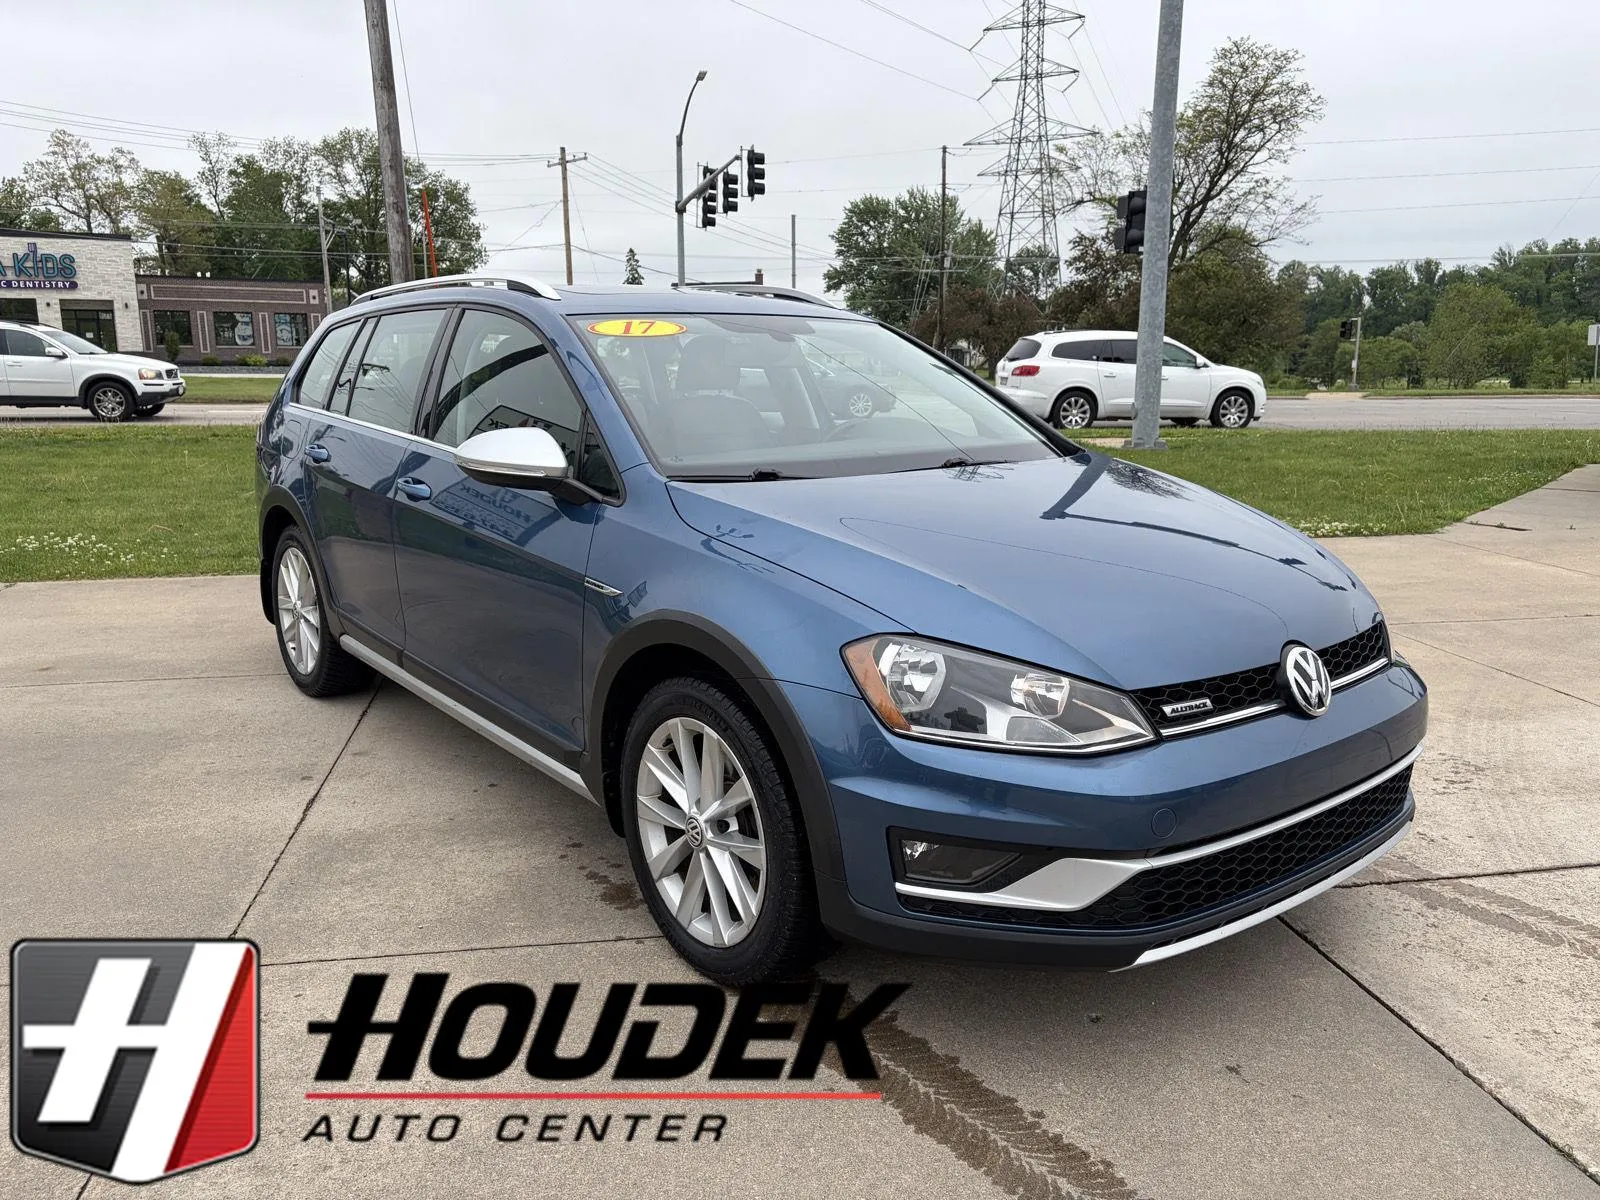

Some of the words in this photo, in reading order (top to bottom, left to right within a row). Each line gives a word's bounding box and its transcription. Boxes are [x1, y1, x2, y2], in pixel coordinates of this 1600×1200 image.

[12, 243, 77, 279] KIDS
[12, 280, 71, 288] DENTISTRY
[622, 320, 657, 335] 17
